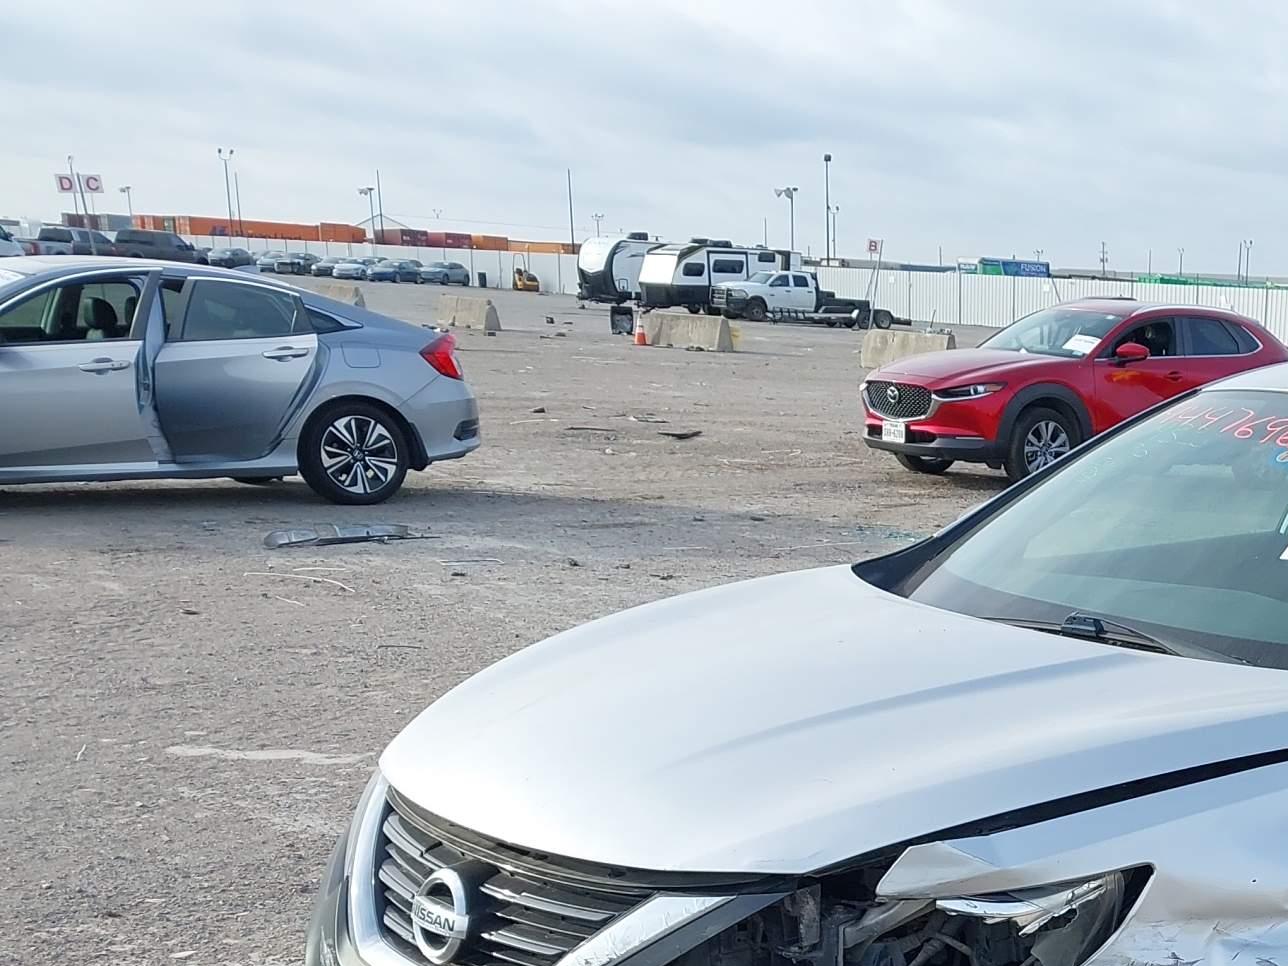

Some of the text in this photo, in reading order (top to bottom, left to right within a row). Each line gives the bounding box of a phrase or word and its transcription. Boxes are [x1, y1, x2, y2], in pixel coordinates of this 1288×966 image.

[58, 176, 73, 191] D
[86, 176, 100, 191] C
[868, 240, 878, 251] B
